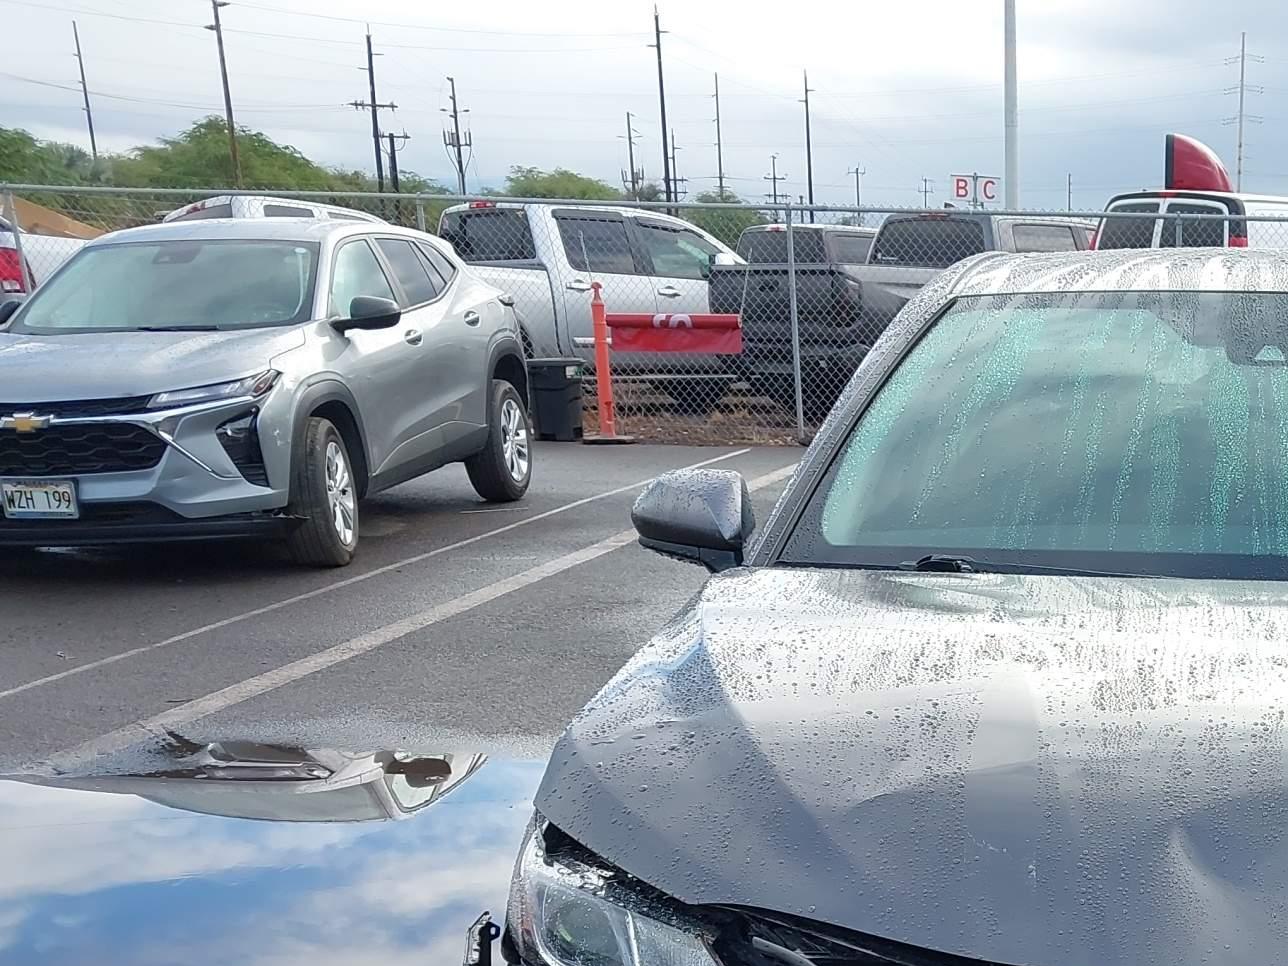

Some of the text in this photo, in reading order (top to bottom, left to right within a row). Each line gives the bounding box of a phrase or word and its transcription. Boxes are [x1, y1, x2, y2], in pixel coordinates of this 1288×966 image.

[955, 178, 996, 200] B C
[4, 490, 71, 509] WZH 199
